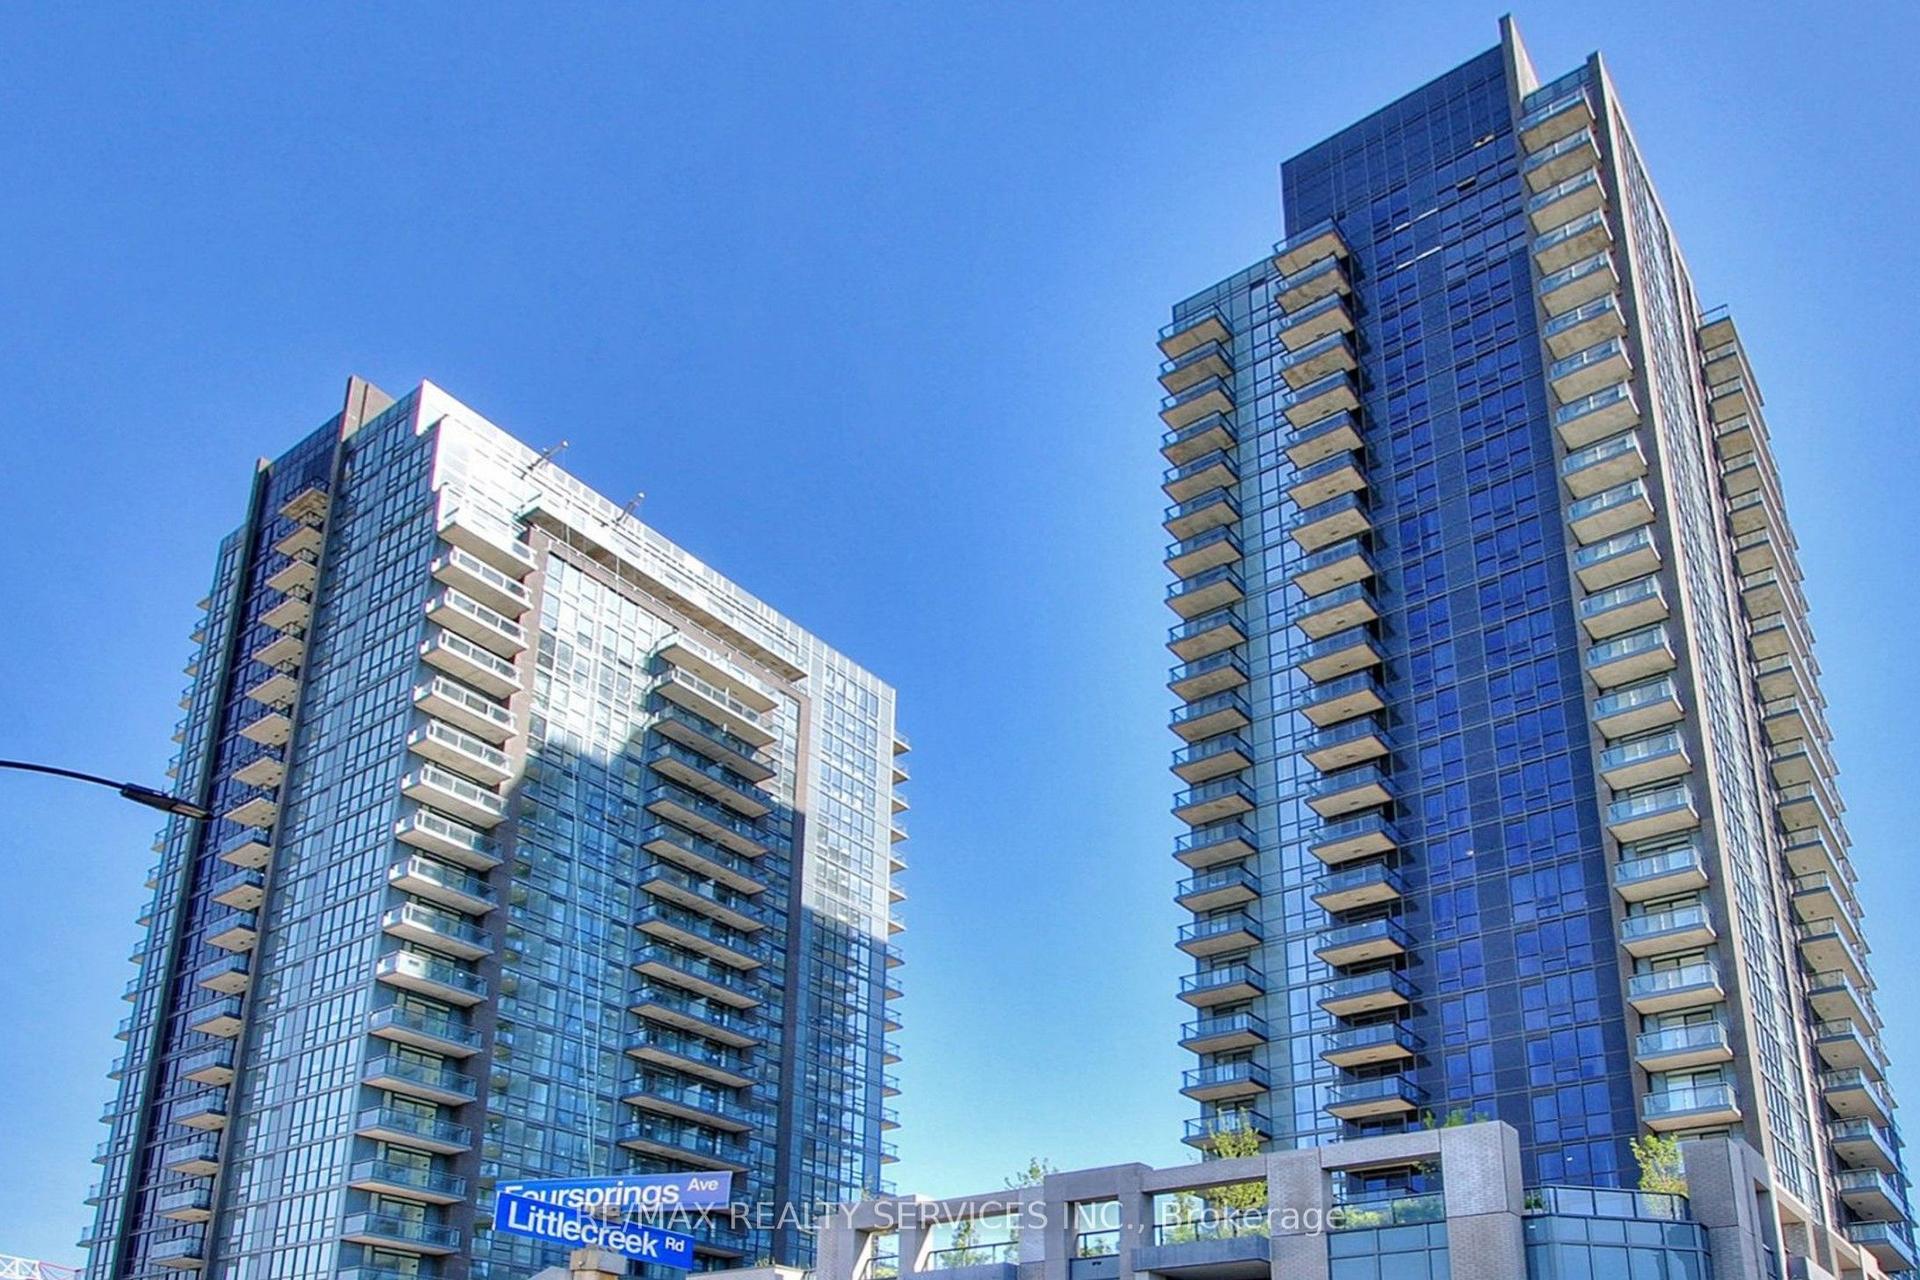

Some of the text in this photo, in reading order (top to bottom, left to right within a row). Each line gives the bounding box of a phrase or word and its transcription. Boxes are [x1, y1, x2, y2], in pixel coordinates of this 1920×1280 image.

[687, 1178, 719, 1192] Ave
[508, 1201, 685, 1258] Littlecreek Rd
